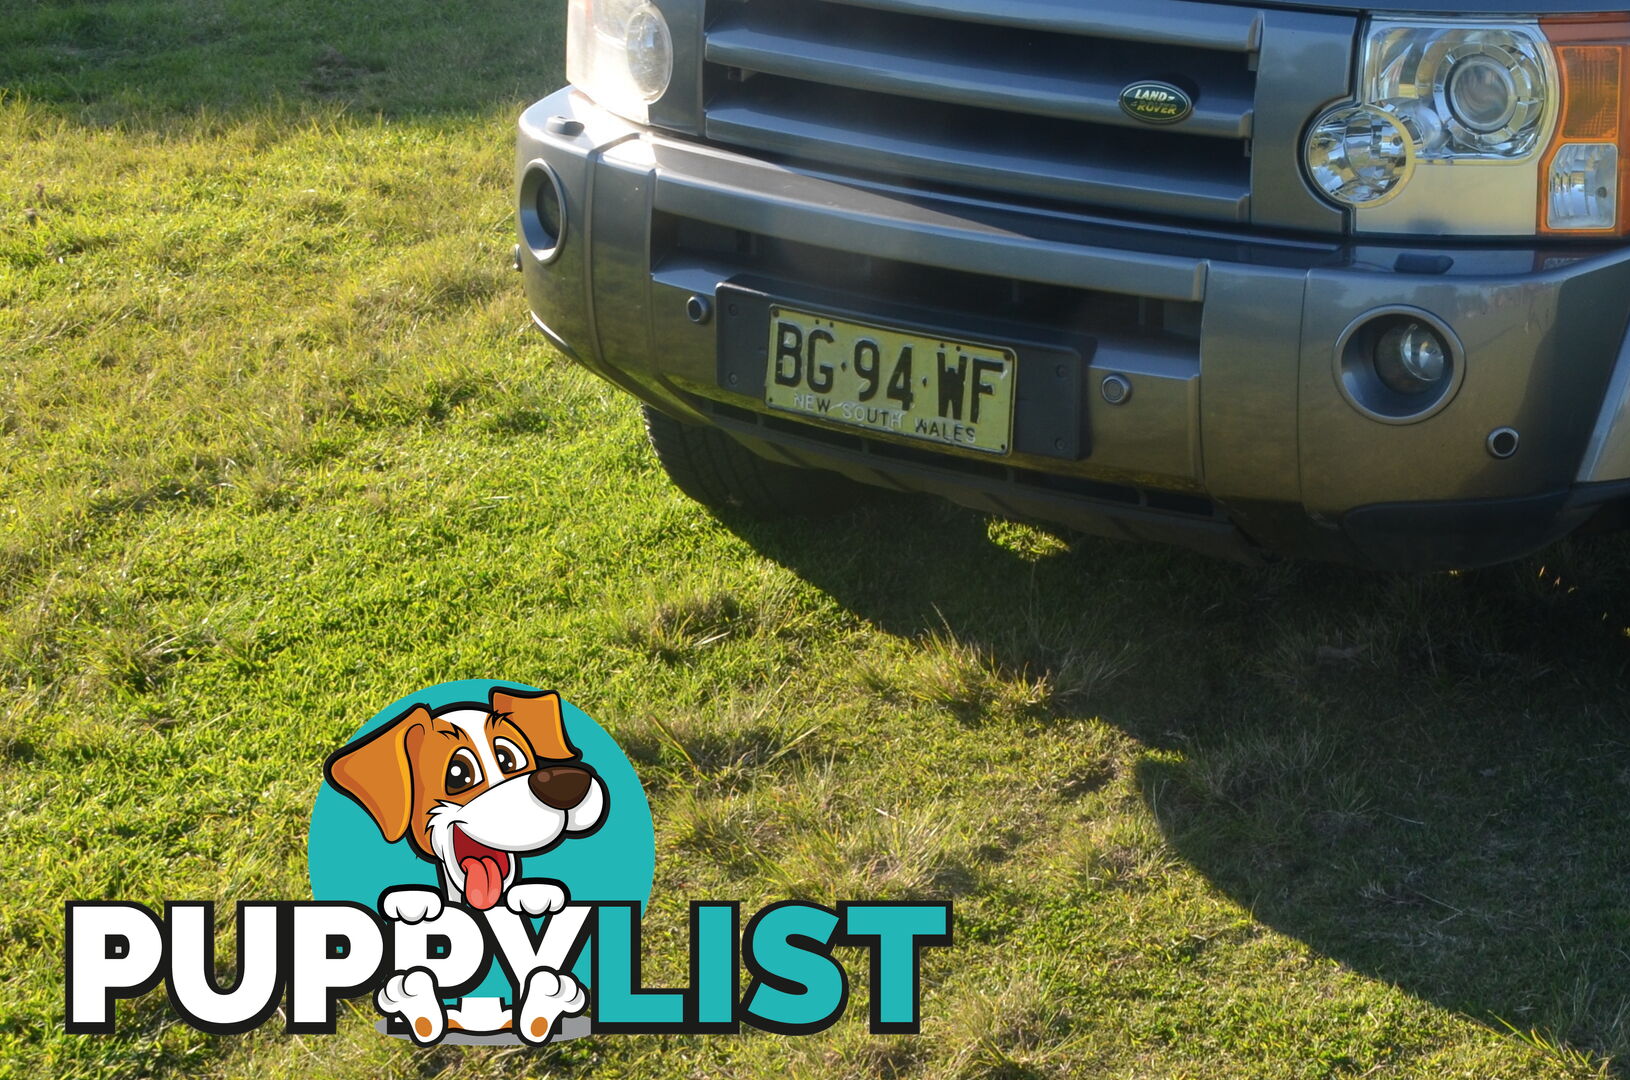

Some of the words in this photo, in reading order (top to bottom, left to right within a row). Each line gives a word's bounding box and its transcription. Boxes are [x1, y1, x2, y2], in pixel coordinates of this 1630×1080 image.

[793, 392, 831, 413] NEW
[841, 401, 903, 428] SOUTH
[915, 418, 976, 444] WALES
